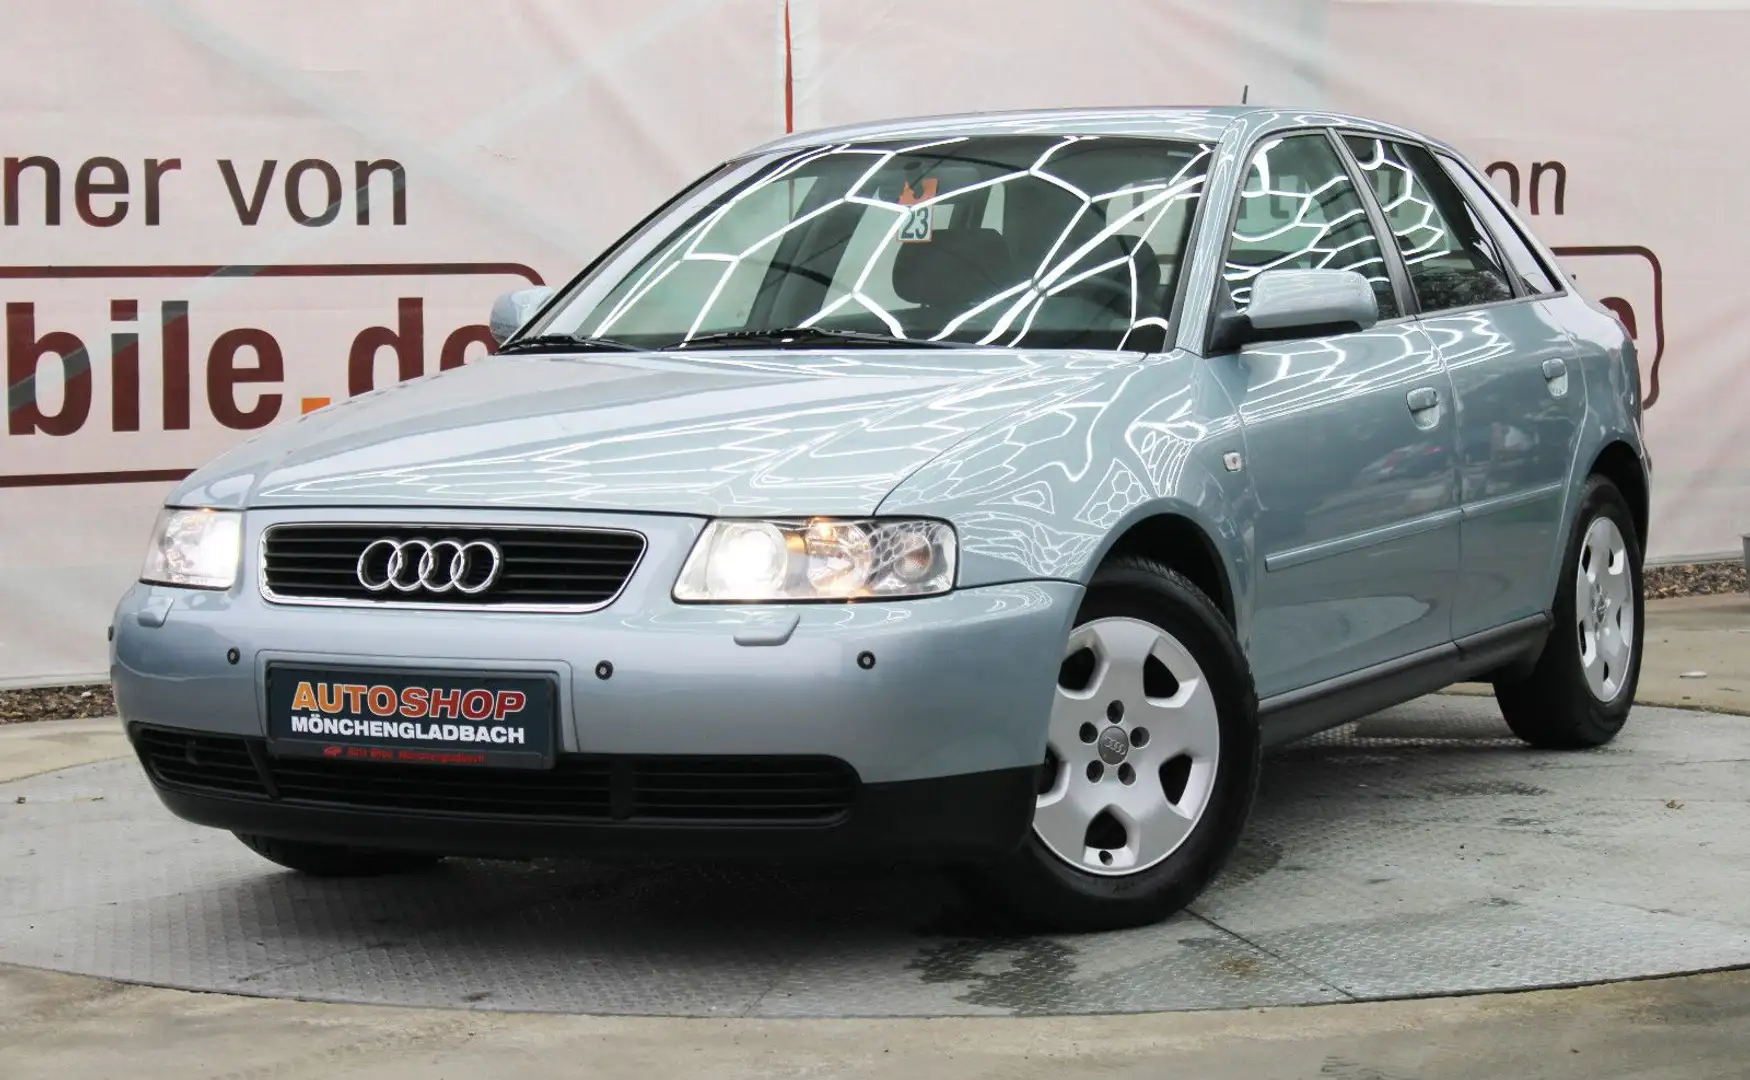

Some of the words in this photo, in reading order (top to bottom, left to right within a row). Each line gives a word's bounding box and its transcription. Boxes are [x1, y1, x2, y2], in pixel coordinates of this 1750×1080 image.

[3, 154, 182, 228] ner
[216, 158, 408, 228] von
[900, 206, 930, 240] 23
[290, 681, 527, 722] AUTOSHOP
[290, 713, 526, 745] MÖNCHENGLADBACH
